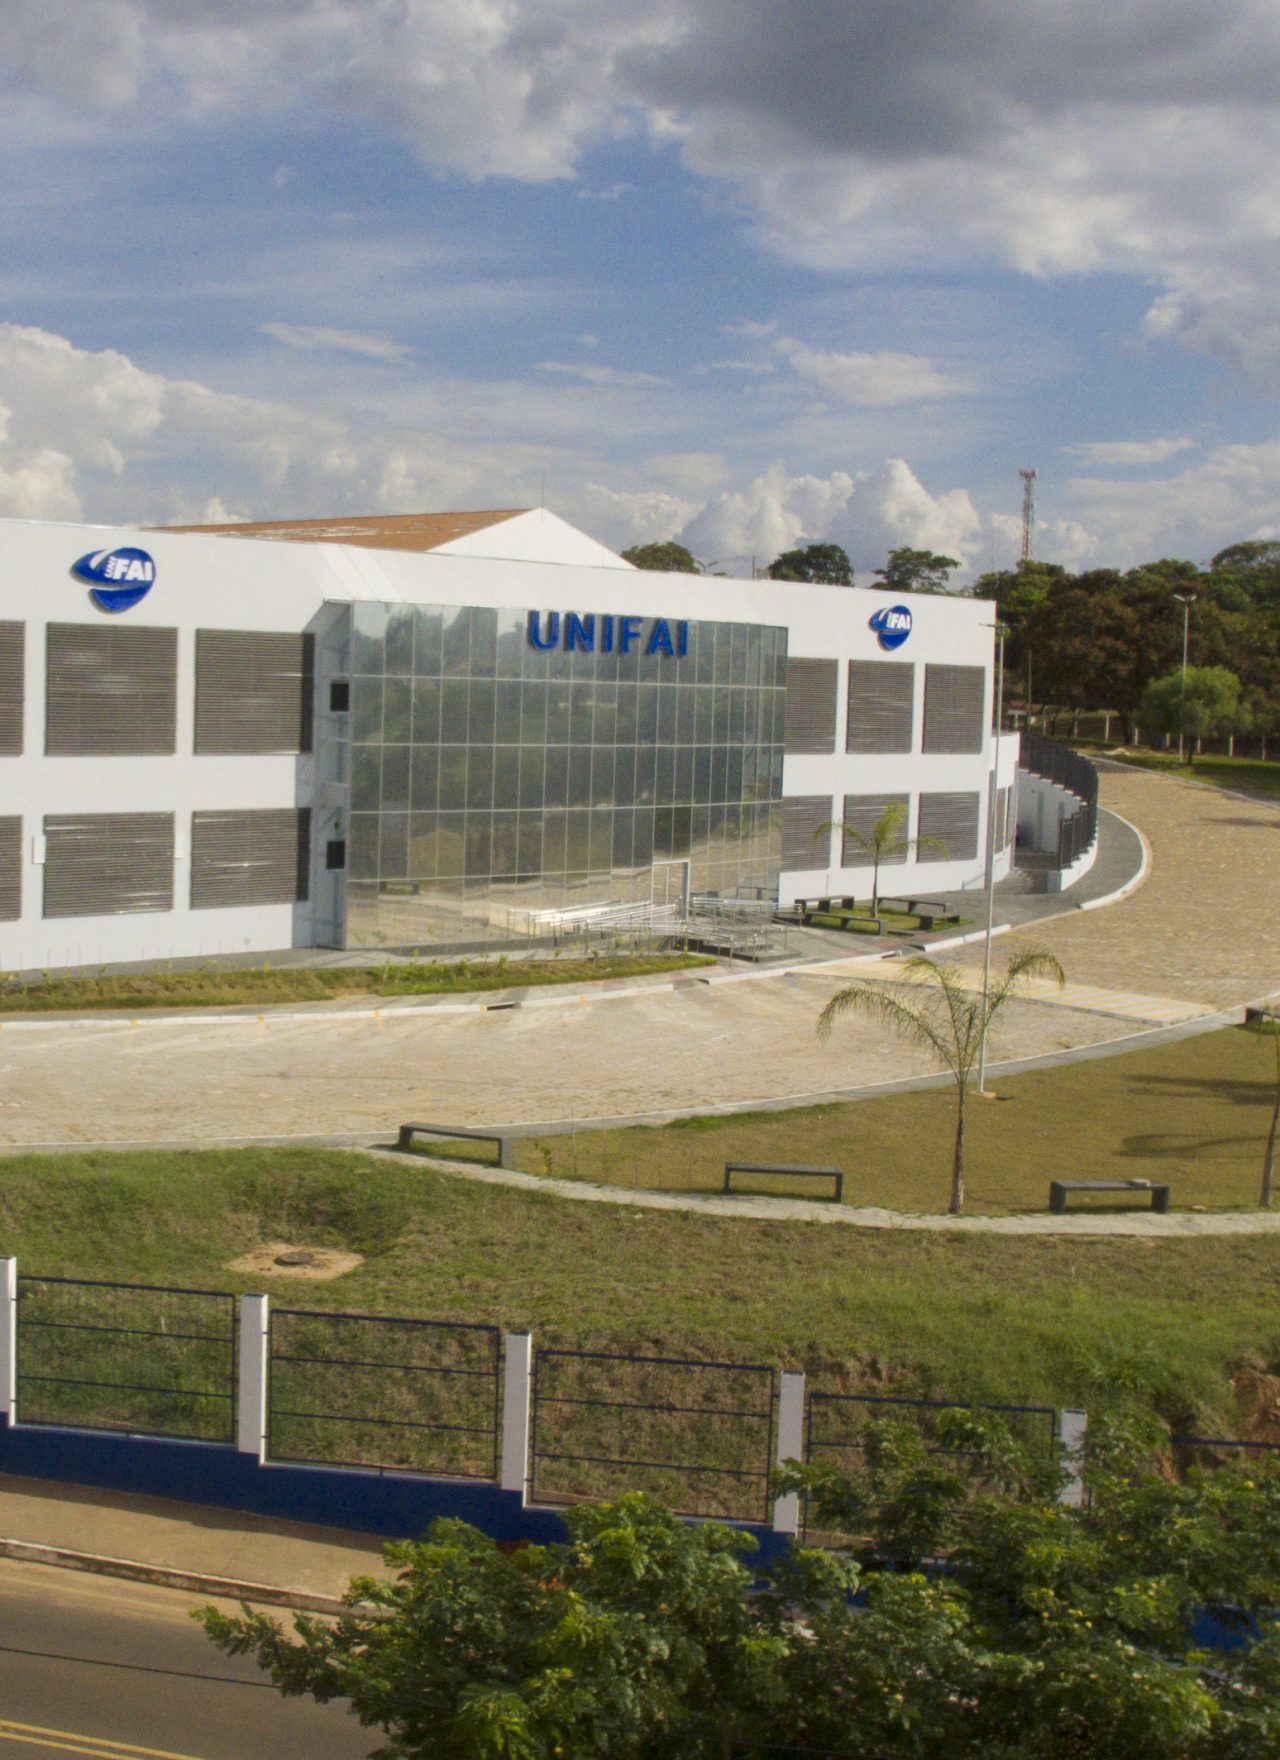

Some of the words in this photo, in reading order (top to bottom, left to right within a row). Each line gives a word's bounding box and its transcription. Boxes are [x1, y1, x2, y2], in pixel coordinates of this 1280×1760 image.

[112, 558, 153, 581] FAI
[890, 613, 911, 629] FAI
[527, 610, 688, 656] UNIFAI
